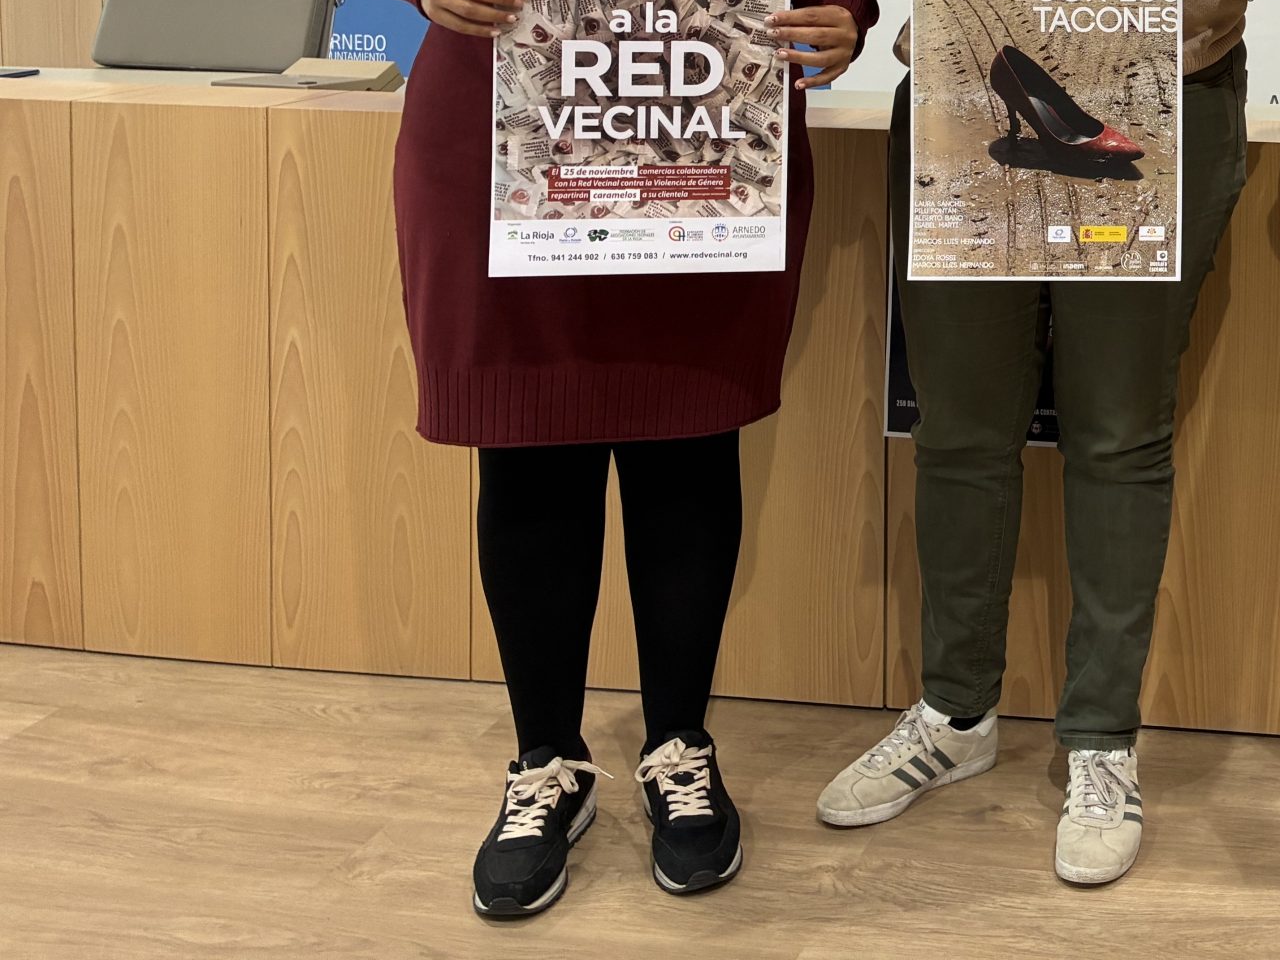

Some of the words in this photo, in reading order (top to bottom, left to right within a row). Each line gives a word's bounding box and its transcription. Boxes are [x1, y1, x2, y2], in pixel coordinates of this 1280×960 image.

[610, 7, 632, 32] a
[644, 2, 678, 33] la
[1033, 6, 1178, 32] TACONES
[562, 40, 725, 97] RED
[537, 105, 746, 139] VECINAL
[521, 231, 530, 240] La
[532, 230, 555, 240] Rioja
